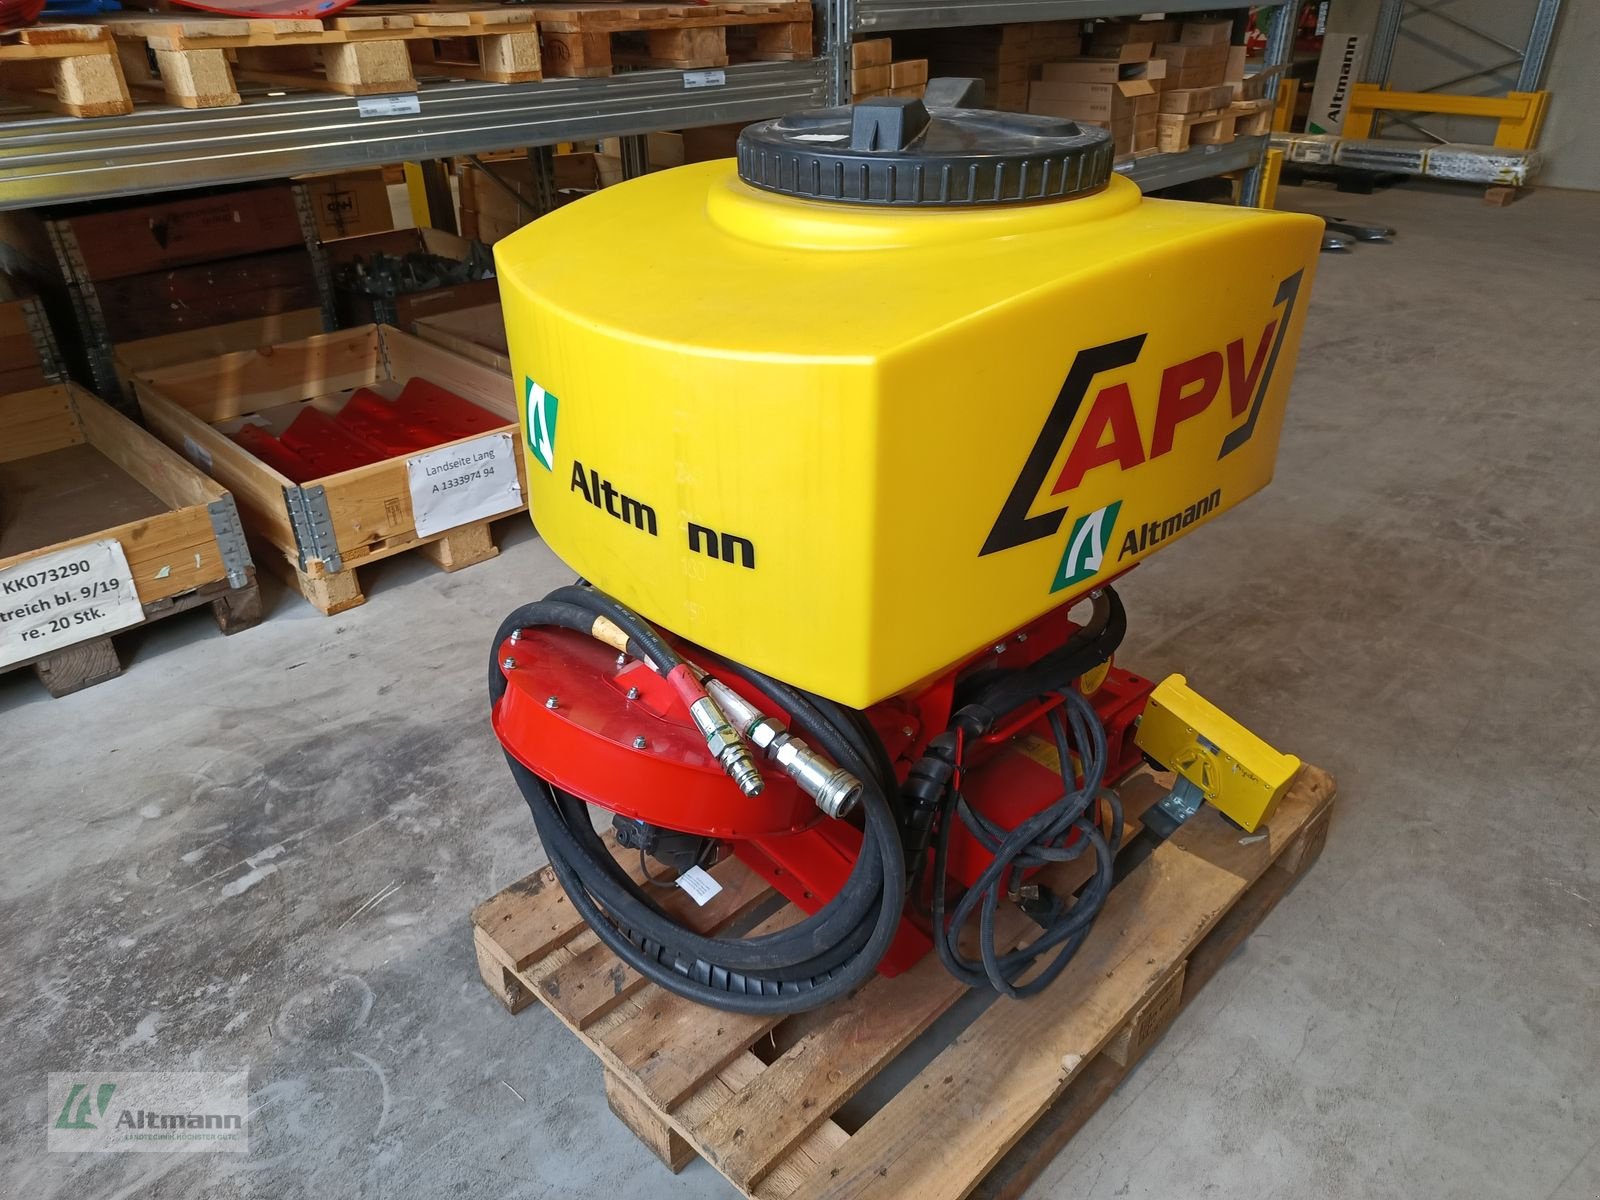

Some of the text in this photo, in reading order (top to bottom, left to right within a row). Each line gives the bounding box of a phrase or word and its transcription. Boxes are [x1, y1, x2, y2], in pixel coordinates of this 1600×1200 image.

[1327, 37, 1358, 123] Altmann
[1050, 319, 1278, 496] APV
[425, 449, 496, 477] Landseite Lang
[432, 466, 495, 494] A 1333974 94
[1117, 488, 1221, 562] Altmann
[2, 560, 90, 595] KK073290
[54, 591, 77, 606] bl.
[80, 578, 119, 598] 9/19
[21, 607, 106, 641] re. 20 Stk.
